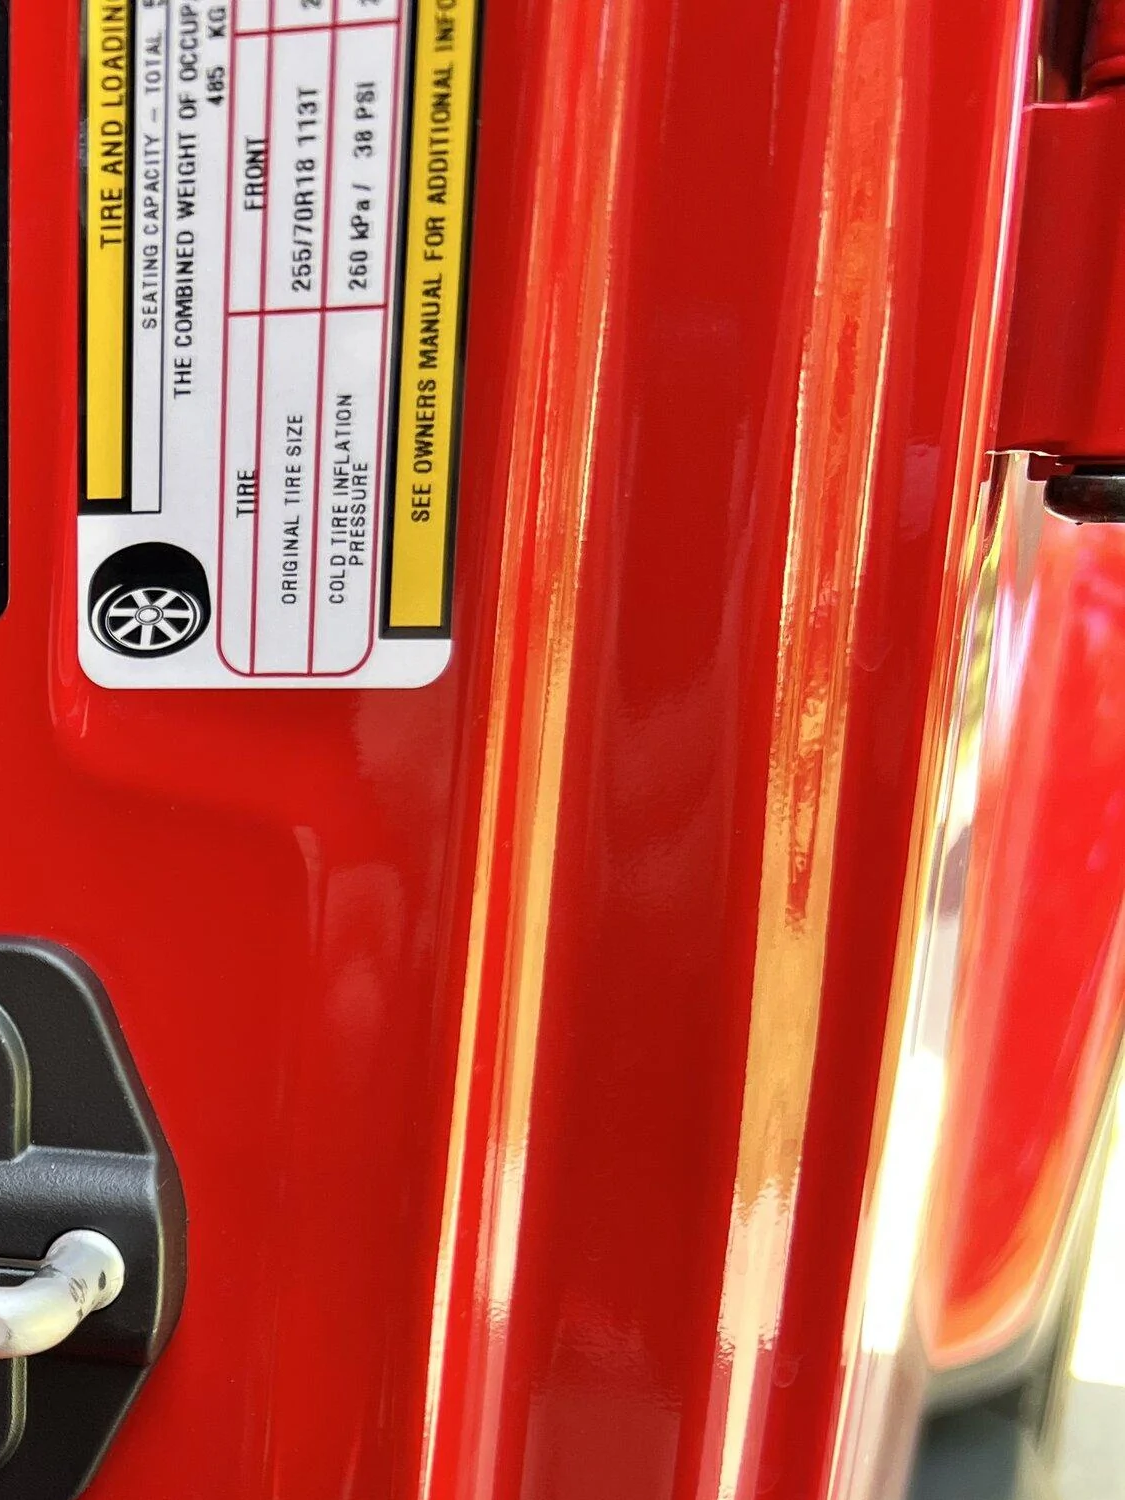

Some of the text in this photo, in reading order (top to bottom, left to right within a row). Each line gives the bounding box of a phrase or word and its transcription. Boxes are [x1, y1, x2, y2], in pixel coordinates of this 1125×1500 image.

[144, 32, 163, 95] TOTAL
[206, 7, 226, 106] 485 KG
[355, 82, 376, 121] PSI
[100, 0, 126, 249] TIRE AND LOADIN
[353, 130, 374, 158] 38
[427, 62, 455, 206] ADDITIONAL
[143, 134, 161, 233] CAPACITY
[173, 0, 199, 399] THE COMBINED WEIGHT OF OCCUP
[244, 137, 268, 211] FRONT
[291, 88, 318, 293] 255/70R18 113T
[347, 250, 368, 290] 260
[423, 216, 446, 261] FOR
[141, 244, 159, 329] SEATING
[418, 273, 443, 369] MANUAL
[412, 379, 437, 474] OWNERS
[236, 470, 257, 518] TIRE
[281, 415, 303, 605] ORIGINAL TIRE SIZE
[328, 394, 353, 604] COLD TIRE INFLATION
[348, 462, 369, 566] PRESSURE
[410, 483, 432, 523] SEE
